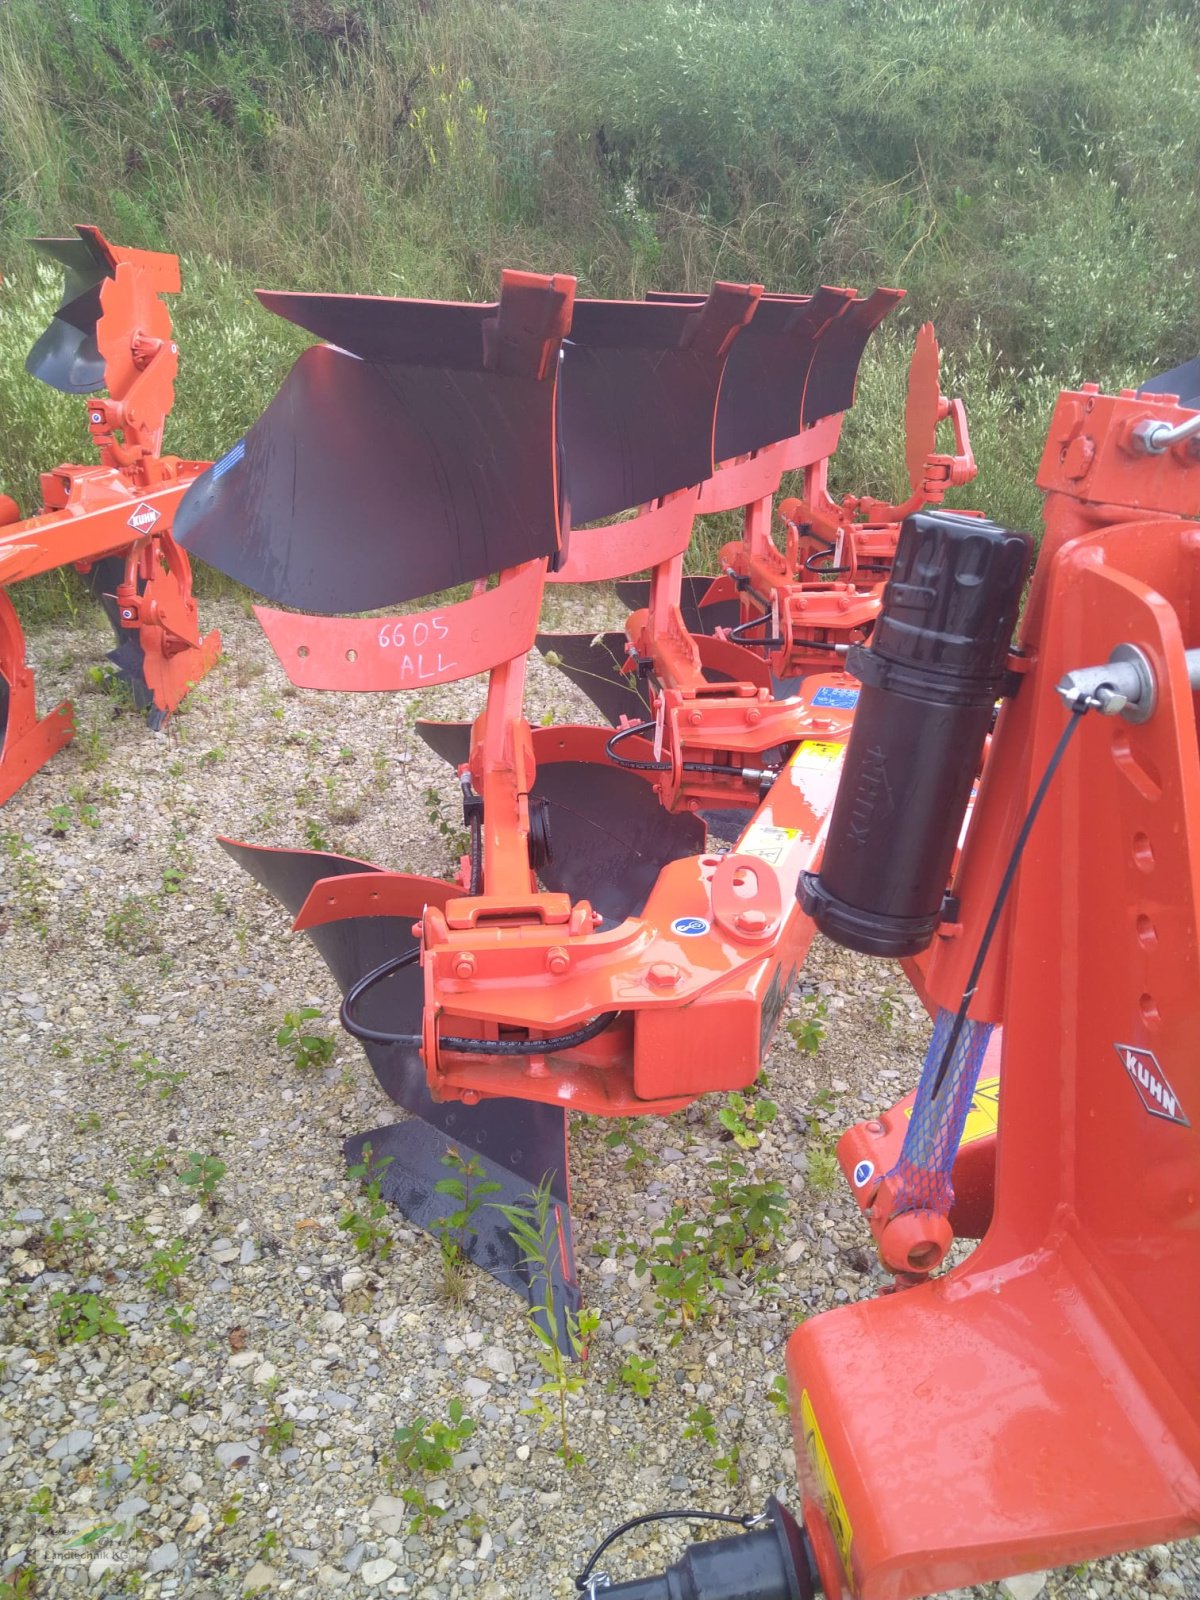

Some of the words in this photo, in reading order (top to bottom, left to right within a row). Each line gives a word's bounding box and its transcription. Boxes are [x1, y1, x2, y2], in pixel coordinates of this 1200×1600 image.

[132, 511, 157, 527] KUHN
[378, 616, 448, 648] 6605
[401, 653, 457, 680] ALL
[1126, 1049, 1175, 1118] KUHN
